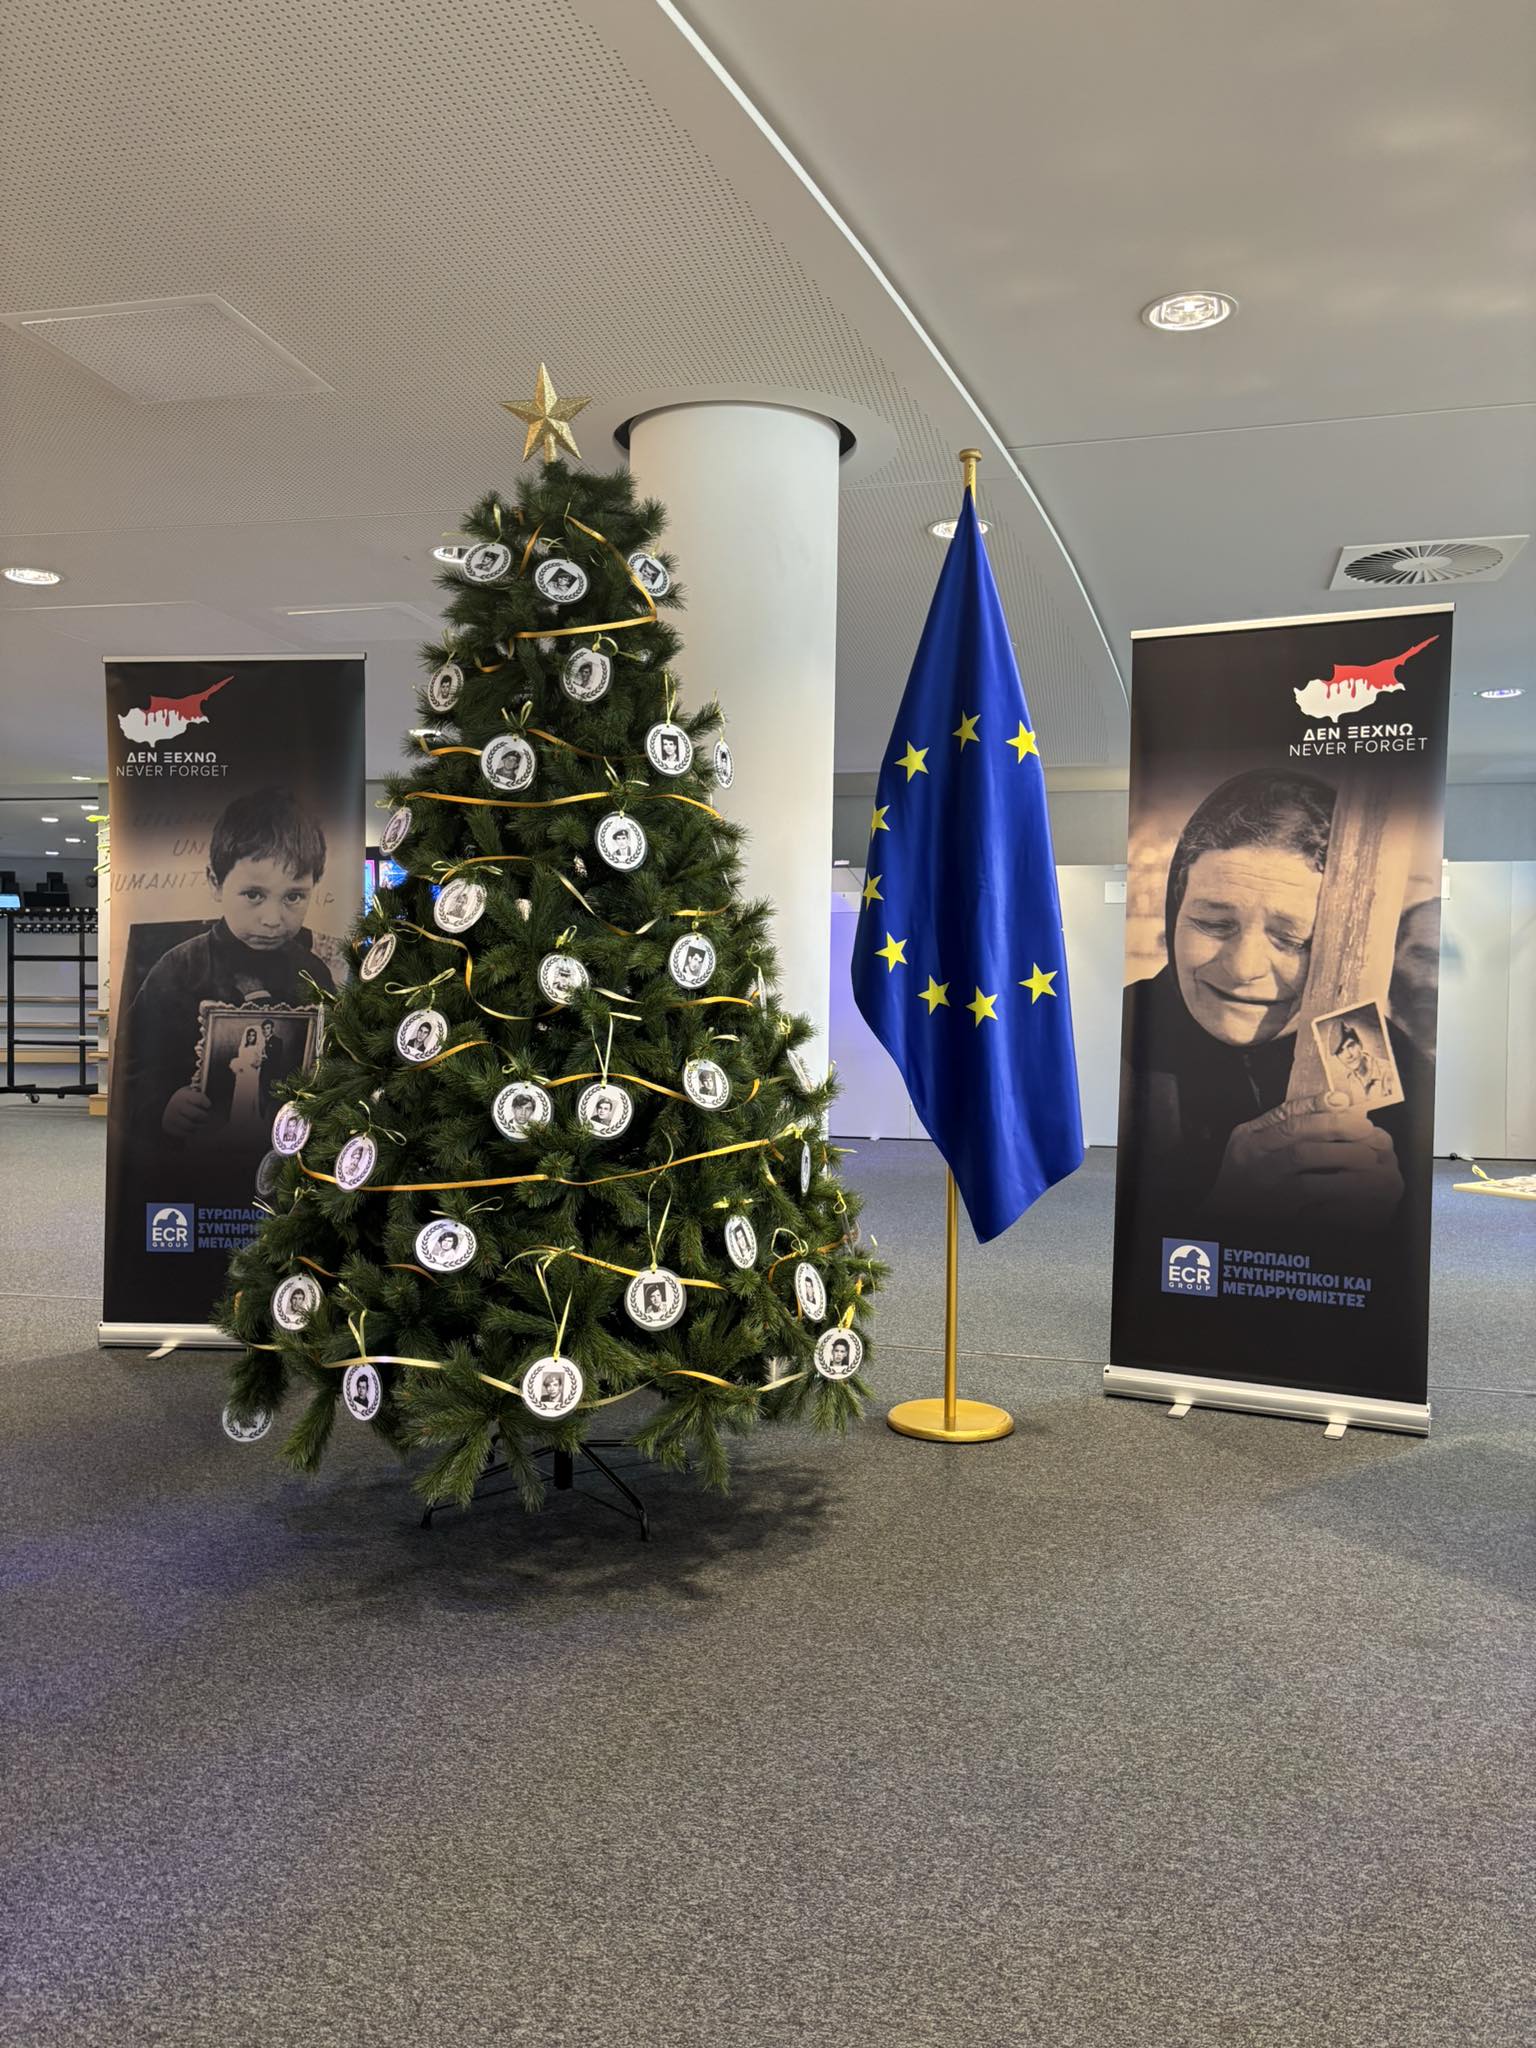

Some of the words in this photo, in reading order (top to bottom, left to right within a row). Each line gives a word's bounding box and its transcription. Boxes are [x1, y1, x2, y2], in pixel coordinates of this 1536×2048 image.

[1303, 727, 1340, 741] ΔΕΝ
[1348, 723, 1413, 739] ΞΕΧΝΩ
[1289, 741, 1347, 757] NEVER
[1354, 737, 1428, 753] FORGET
[126, 752, 158, 763] ΔΕΝ
[163, 752, 217, 763] ΞΕΧΝΩ
[116, 765, 163, 777] NEVER
[170, 764, 229, 777] FORGET
[152, 1227, 188, 1242] ECR
[1223, 1248, 1310, 1268] ΕΥΡΩΠΑΙΟΙ
[1168, 1265, 1210, 1285] ECR
[1223, 1265, 1339, 1289] ΣΥΝΤΗΡΗΤΙΚΟΙ
[1343, 1276, 1372, 1292] ΚΑΙ
[1168, 1281, 1211, 1292] GROUP
[1222, 1281, 1366, 1308] ΜΕΤΑΡΡΥΘΜΙΣΤΕΣ
